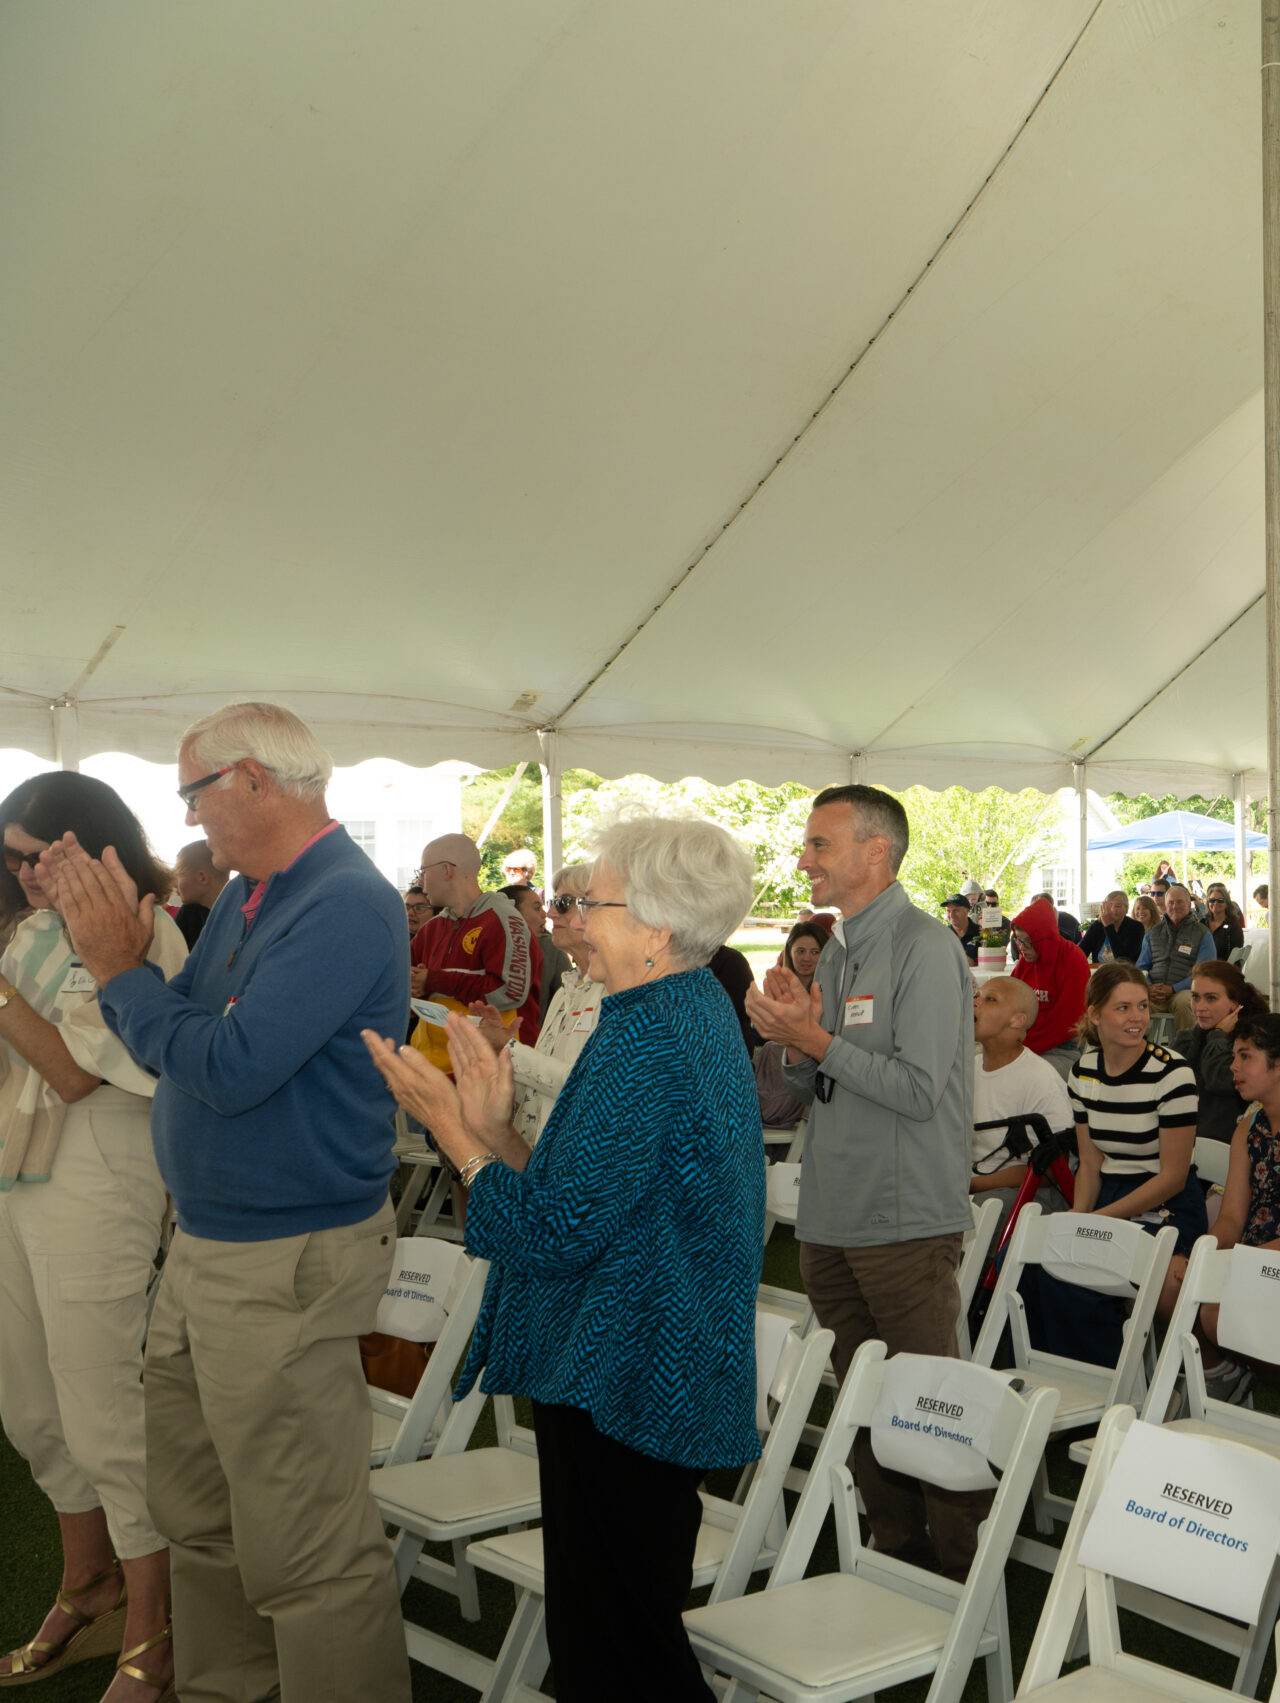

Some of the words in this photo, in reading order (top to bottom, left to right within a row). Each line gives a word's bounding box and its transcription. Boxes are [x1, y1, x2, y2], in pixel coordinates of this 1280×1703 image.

[503, 915, 527, 1002] WASHINGTON
[1076, 1226, 1113, 1241] RESERVED
[399, 1270, 431, 1284] RESERVED
[385, 1288, 402, 1297] oard
[403, 1289, 411, 1299] of
[916, 1396, 964, 1418] RESERVED
[891, 1415, 921, 1432] Board
[922, 1423, 933, 1434] of
[934, 1425, 974, 1447] Directors
[1162, 1482, 1234, 1517] RESERVED
[1125, 1498, 1168, 1525] Board
[1168, 1516, 1186, 1530] of
[1185, 1519, 1250, 1553] Directors
